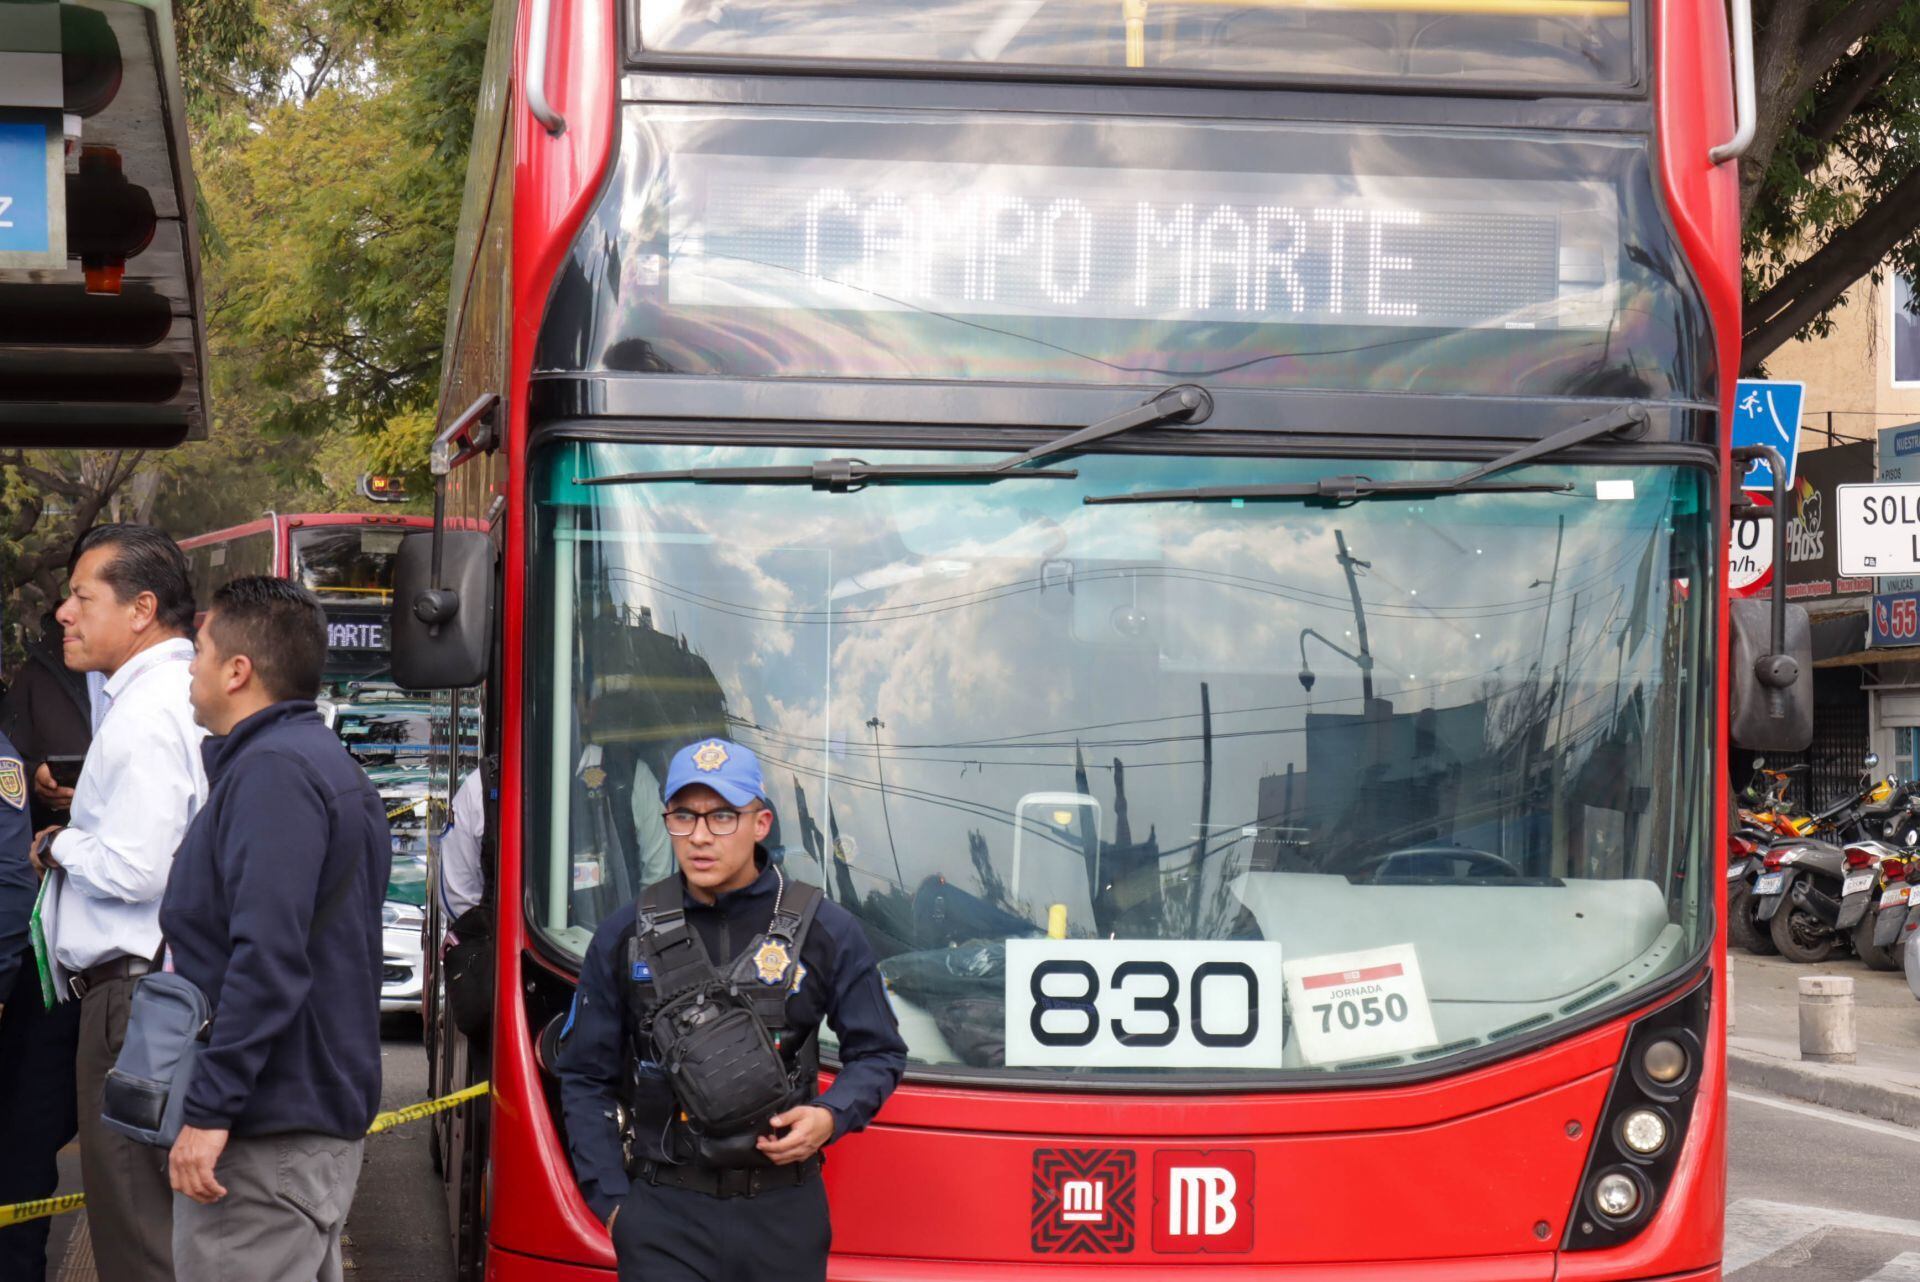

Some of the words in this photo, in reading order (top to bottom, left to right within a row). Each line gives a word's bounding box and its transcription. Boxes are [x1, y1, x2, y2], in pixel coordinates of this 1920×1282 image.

[805, 187, 1092, 305] CAMPO
[1135, 201, 1420, 316] MARTE
[1885, 468, 1902, 480] PISOS
[1863, 495, 1920, 525] SOL
[1728, 518, 1760, 550] 0
[1891, 598, 1917, 638] 55
[1030, 959, 1259, 1048] 830
[1330, 984, 1384, 1000] JORNADA
[1312, 993, 1409, 1033] 7050
[1169, 1167, 1237, 1236] MB
